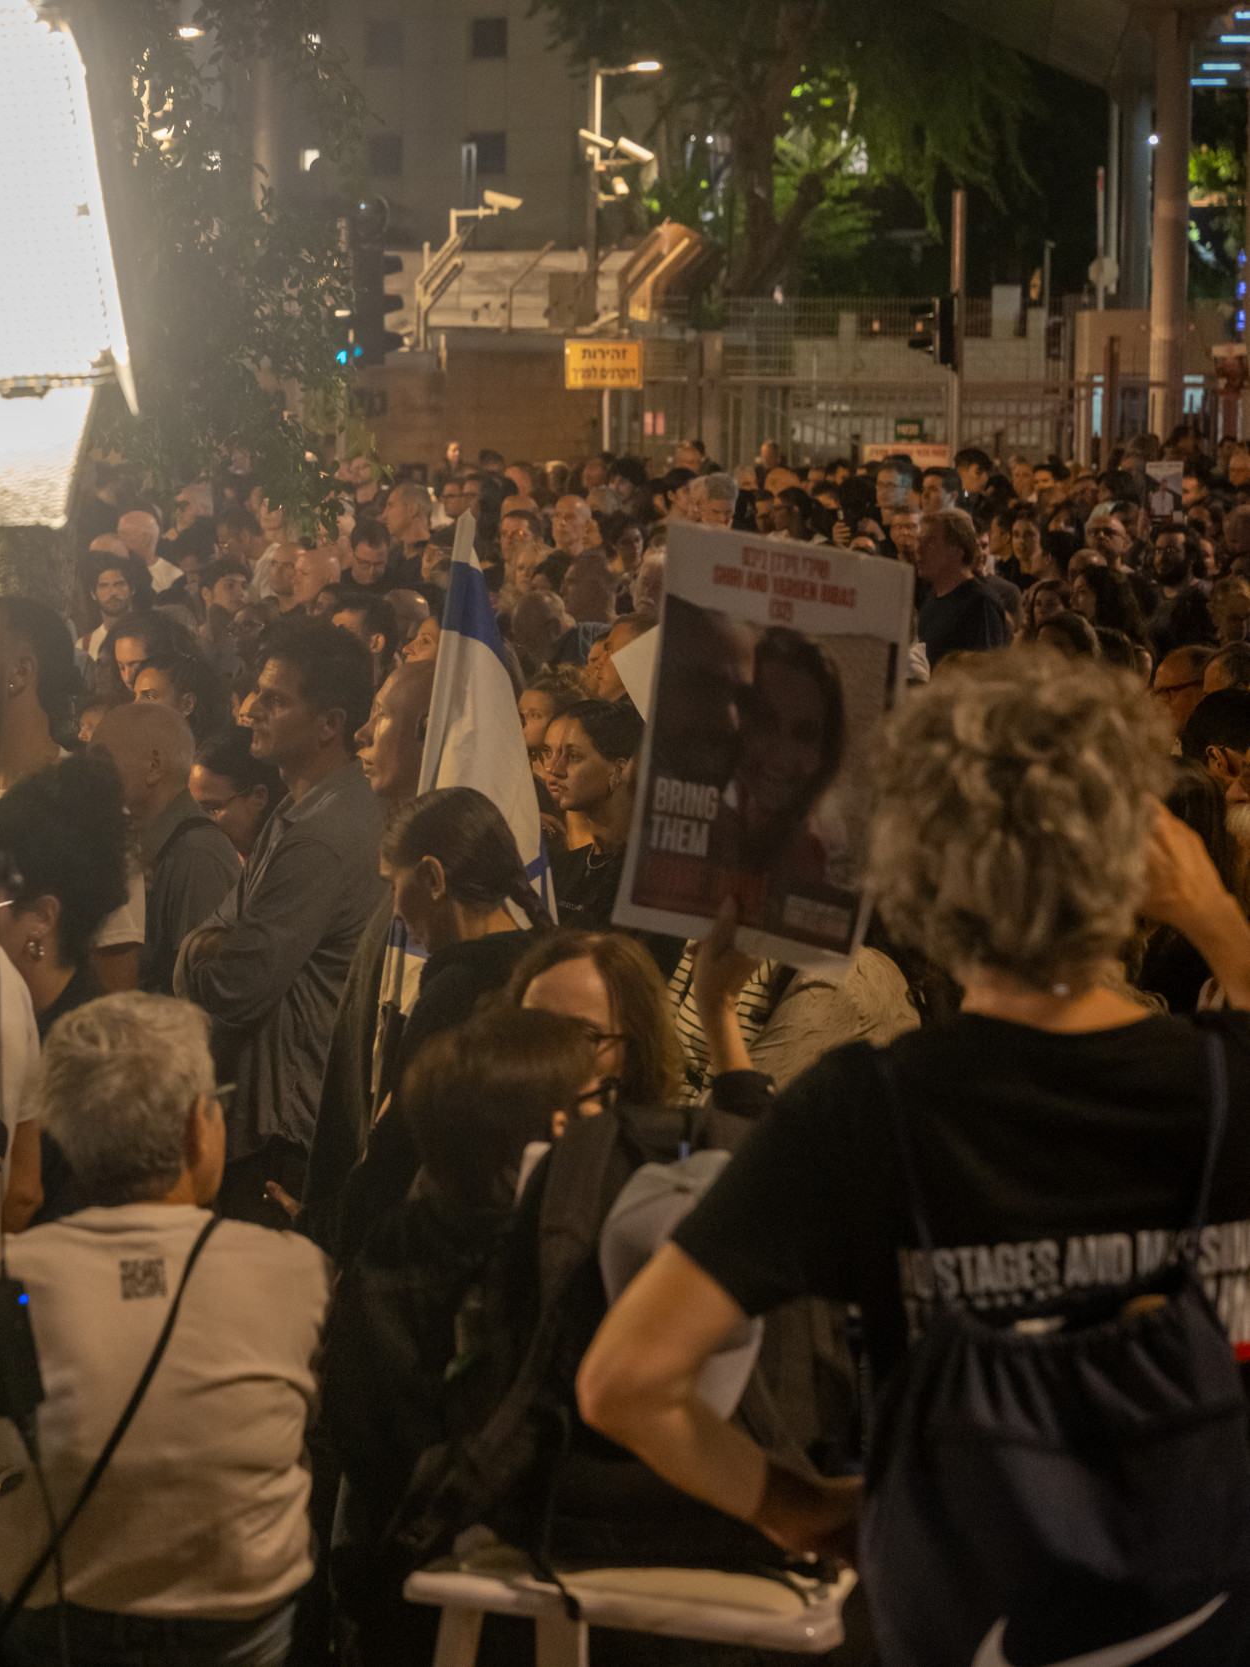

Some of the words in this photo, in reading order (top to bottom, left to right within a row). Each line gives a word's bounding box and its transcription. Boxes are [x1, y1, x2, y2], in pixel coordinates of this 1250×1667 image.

[582, 348, 627, 360] זהירות
[653, 775, 719, 822] BRING
[650, 813, 710, 858] THEM
[1065, 1233, 1132, 1287] AND
